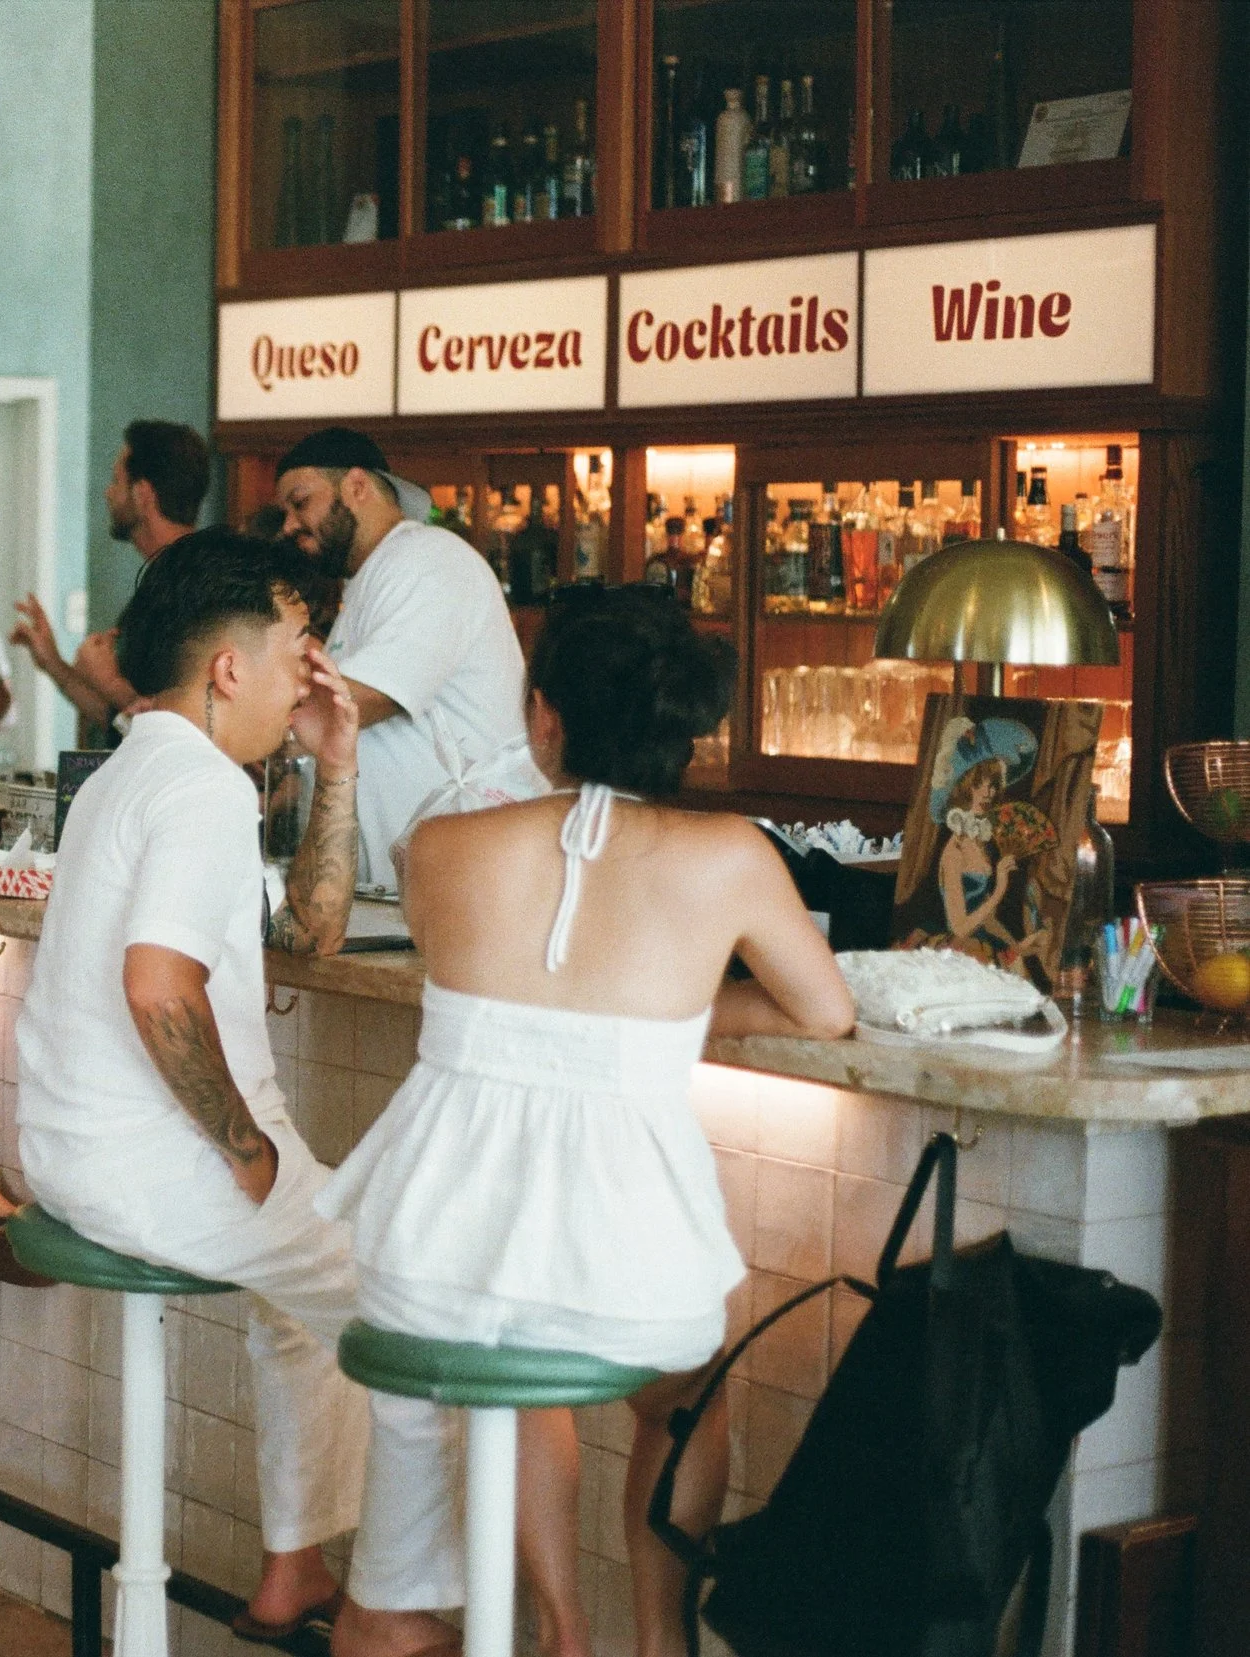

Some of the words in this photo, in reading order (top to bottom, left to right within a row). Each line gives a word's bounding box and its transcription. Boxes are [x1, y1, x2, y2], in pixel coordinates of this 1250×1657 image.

[626, 295, 850, 364] Cocktails
[931, 279, 1072, 343] Wine
[251, 336, 360, 391] Queso
[417, 325, 583, 373] Cerveza
